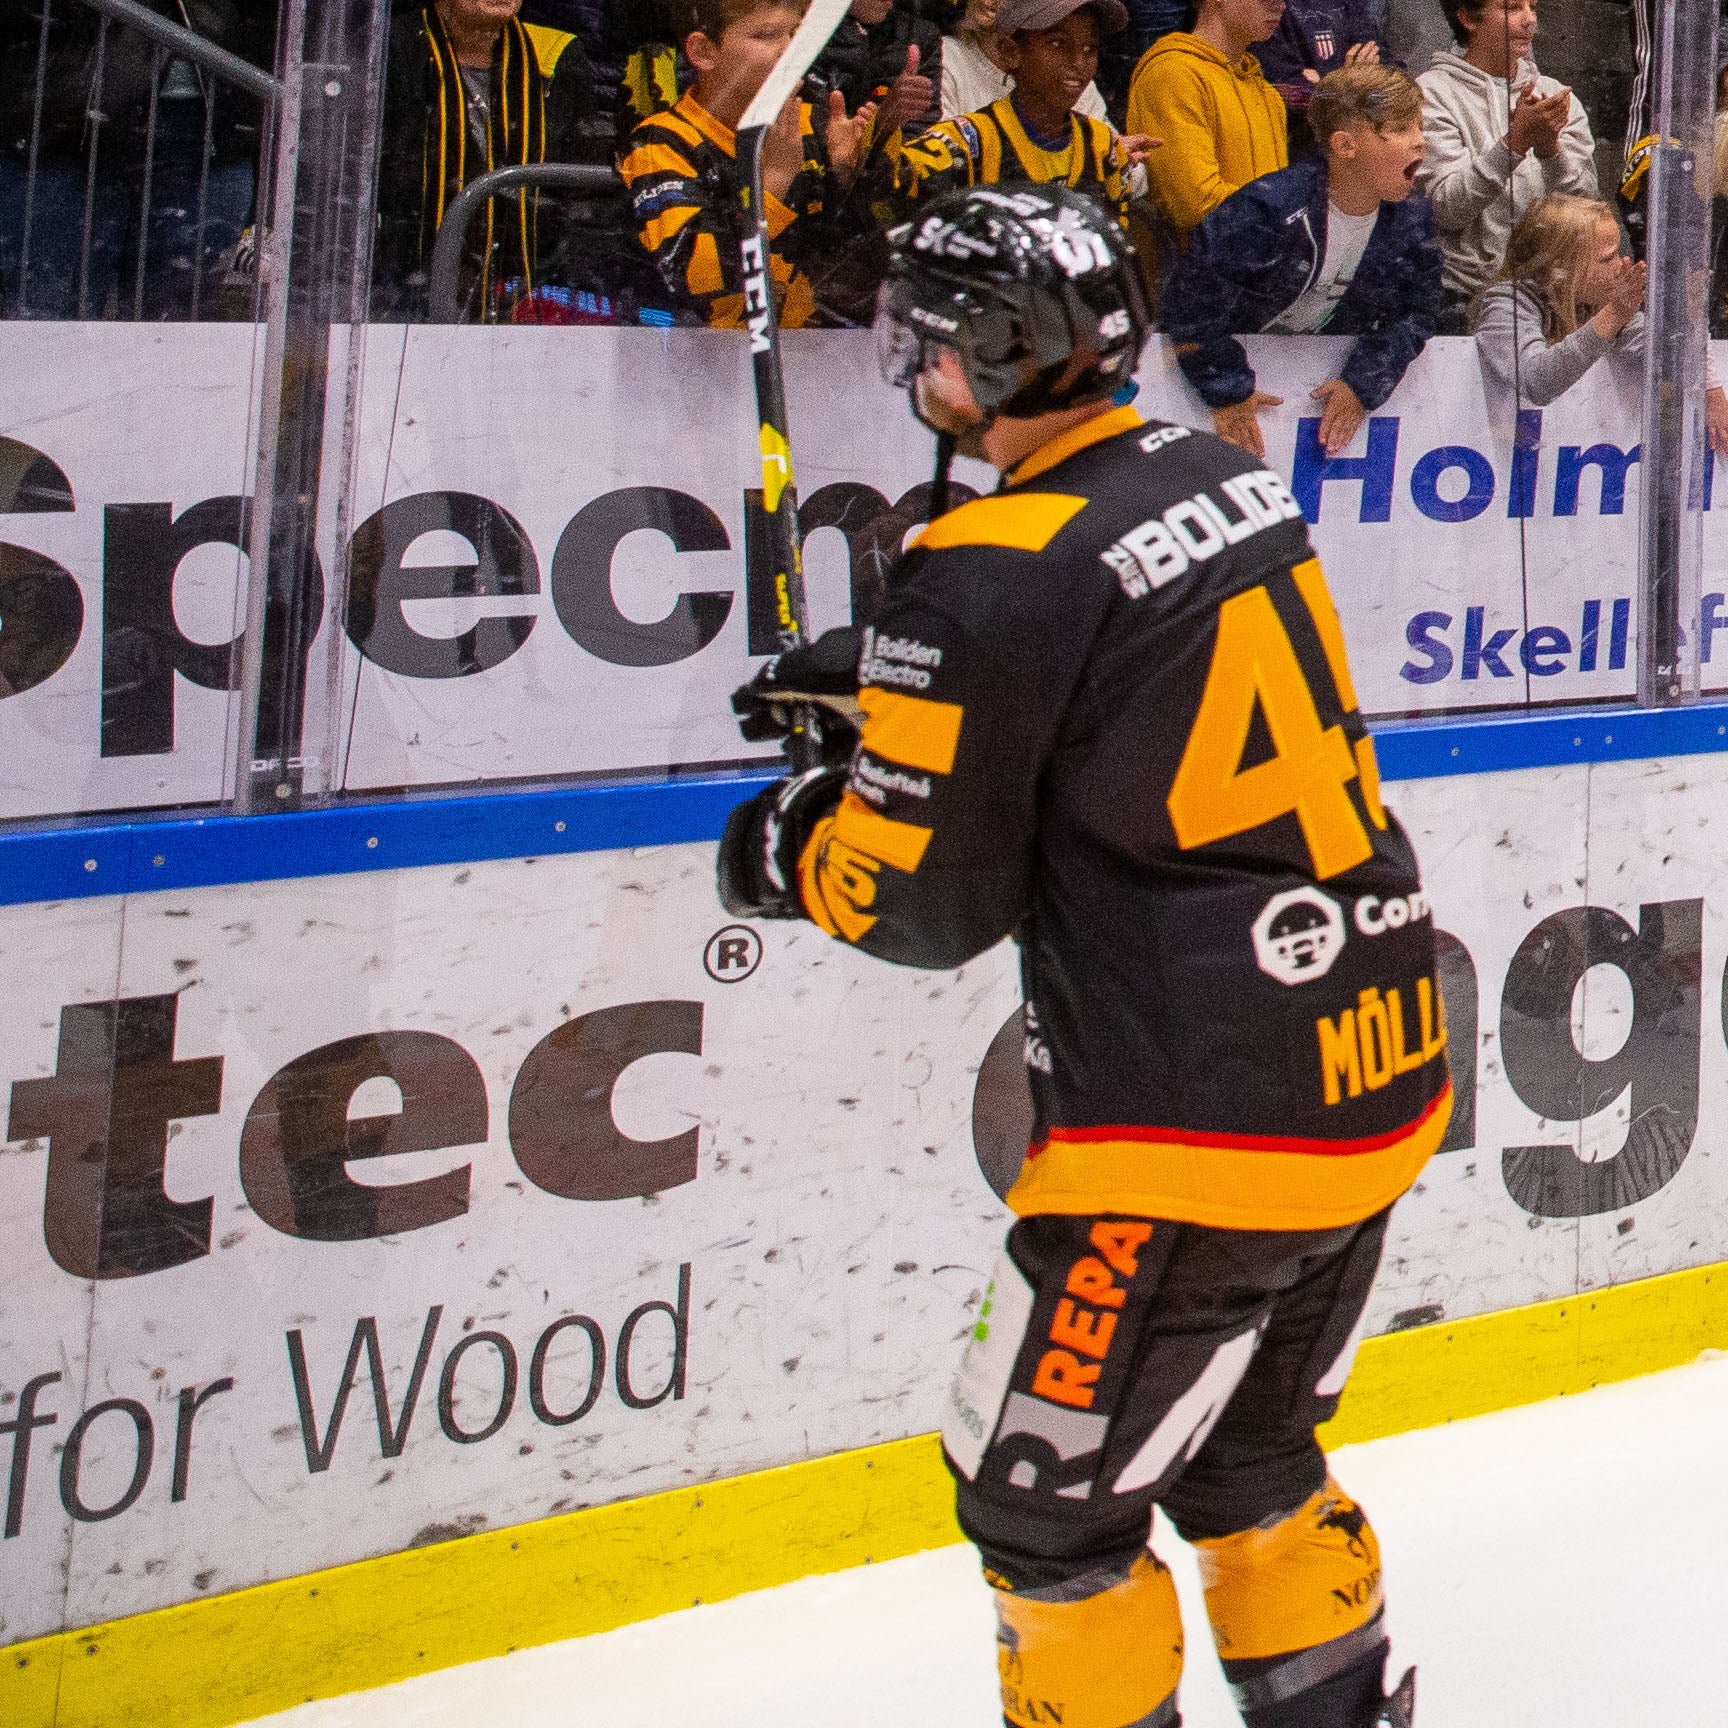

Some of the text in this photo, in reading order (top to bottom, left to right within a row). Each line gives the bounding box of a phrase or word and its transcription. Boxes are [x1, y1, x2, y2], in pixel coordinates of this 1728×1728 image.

[740, 236, 773, 354] CCM
[0, 1263, 692, 1541] for Wood
